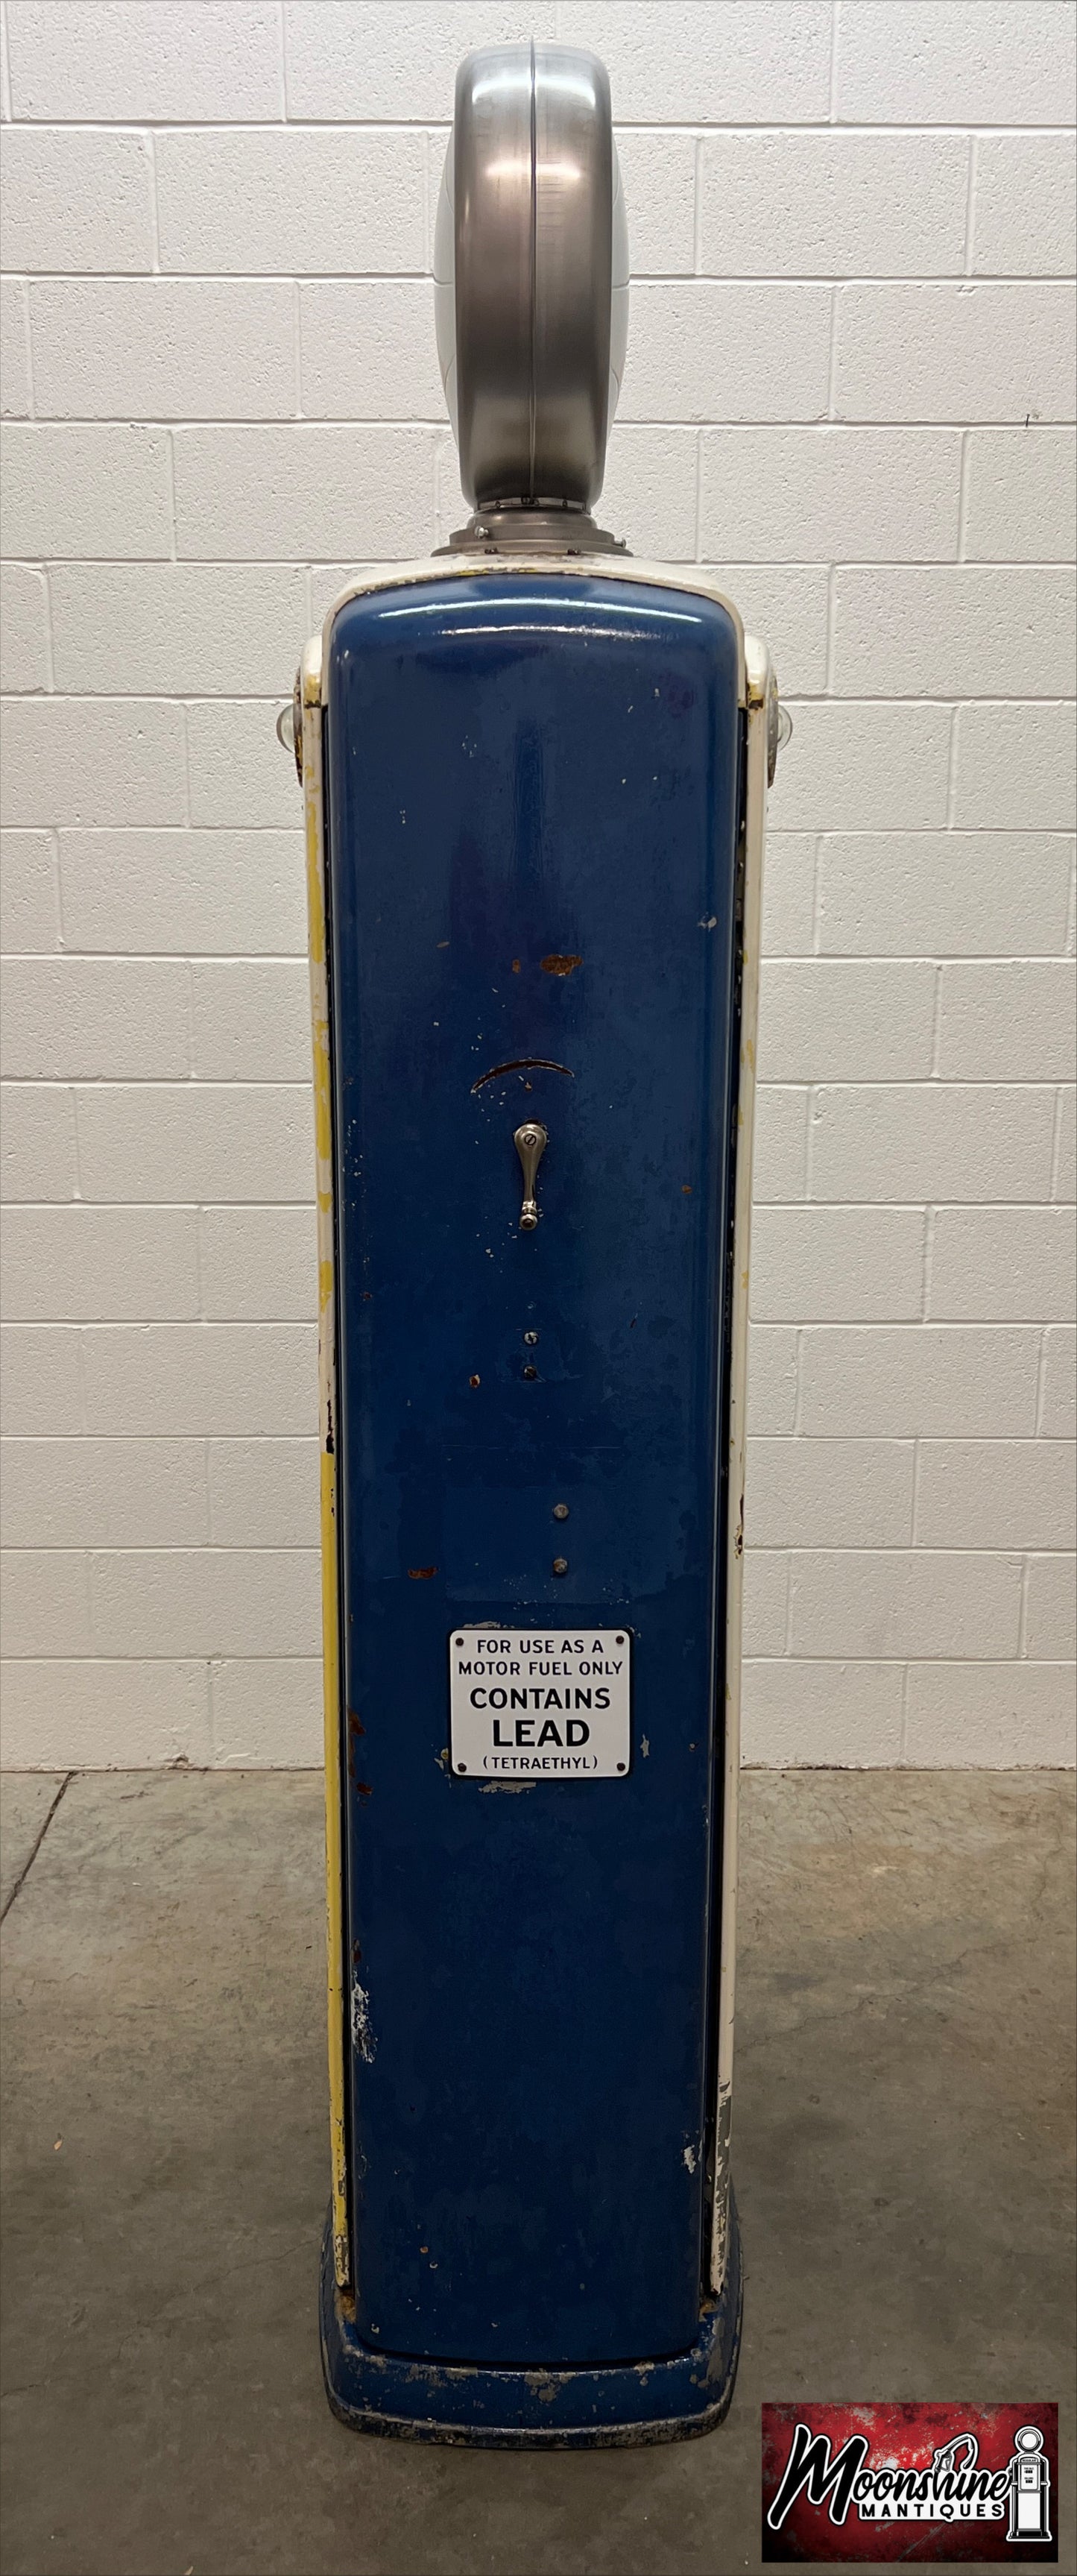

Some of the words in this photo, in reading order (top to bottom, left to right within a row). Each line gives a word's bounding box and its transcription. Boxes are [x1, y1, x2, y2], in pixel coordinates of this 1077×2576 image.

[477, 1640, 511, 1654] FOR
[519, 1640, 555, 1654] USE
[560, 1640, 585, 1654] AS
[592, 1640, 604, 1654] A
[458, 1661, 521, 1675] MOTOR
[529, 1661, 572, 1675] FUEL
[579, 1661, 623, 1675] ONLY
[470, 1687, 610, 1709] CONTAINS
[493, 1719, 590, 1747] LEAD
